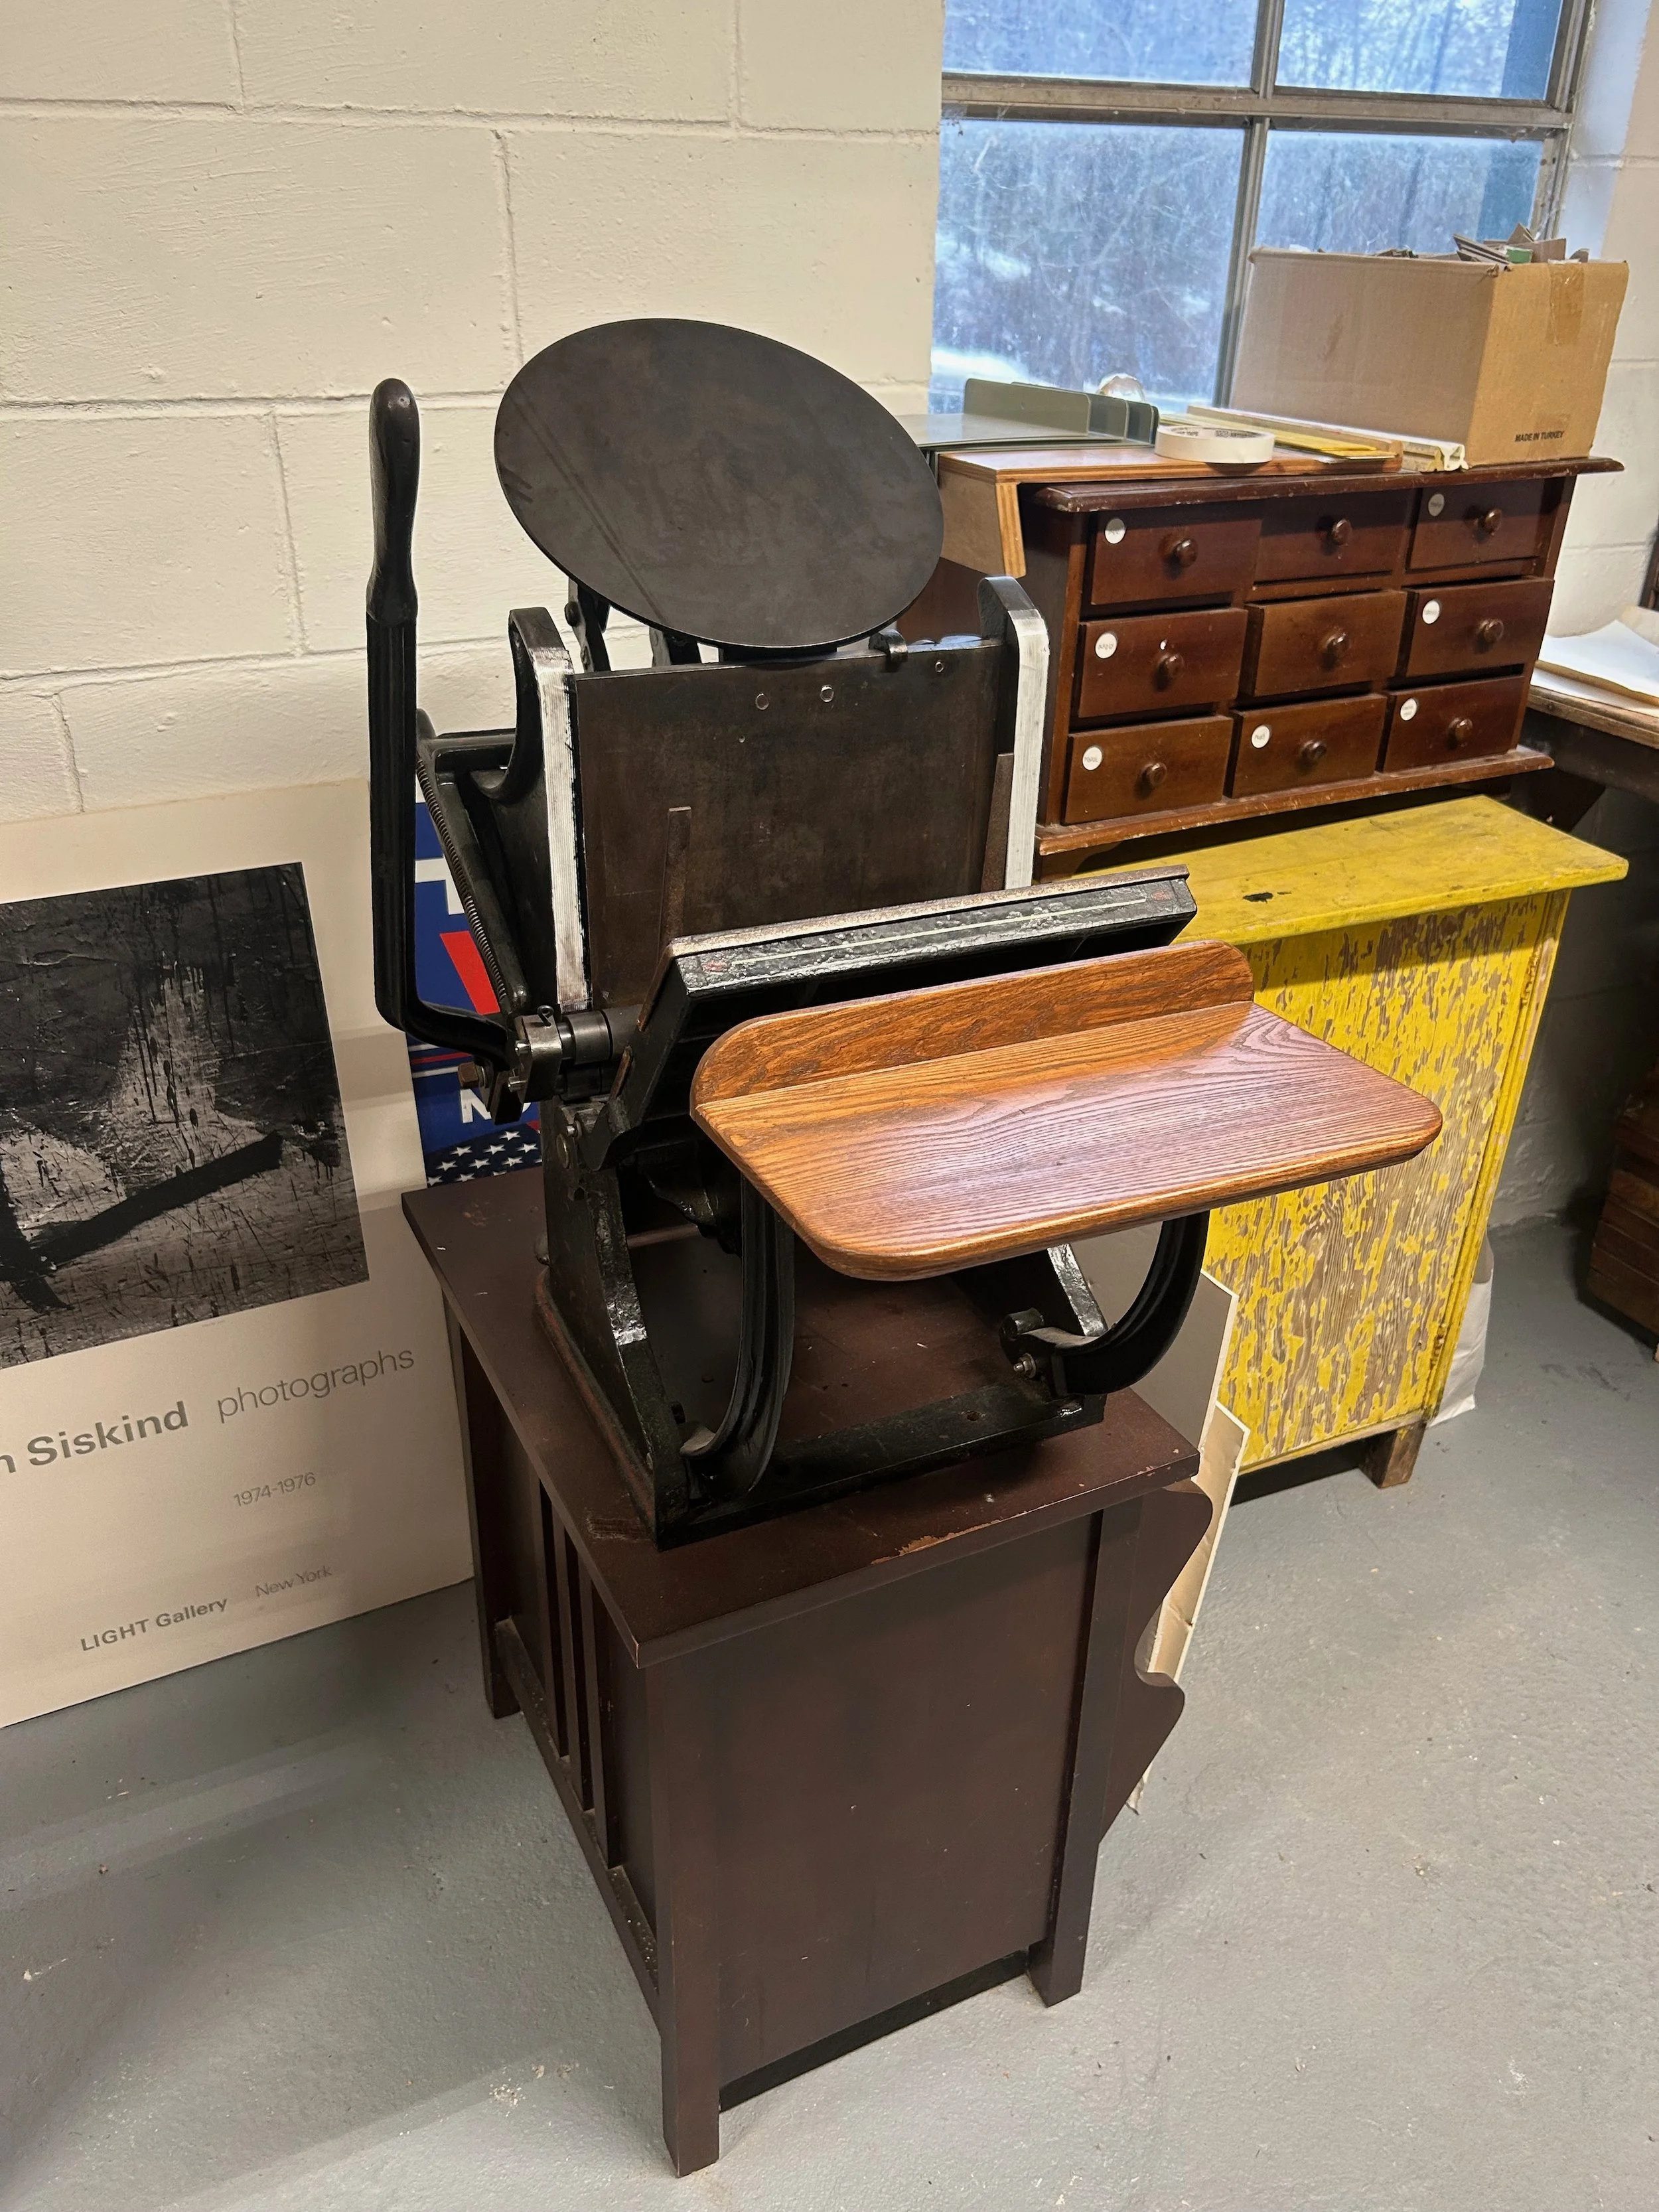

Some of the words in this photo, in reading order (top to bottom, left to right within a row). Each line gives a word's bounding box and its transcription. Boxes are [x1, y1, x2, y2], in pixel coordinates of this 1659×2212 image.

[1515, 433, 1532, 442] MADE
[1541, 430, 1564, 439] TURKEY
[27, 1400, 188, 1465] Siskind
[218, 1350, 414, 1424] photographs
[234, 1472, 316, 1507] 1974-1976
[80, 1619, 150, 1651] LIGHT
[155, 1598, 228, 1628] Gallery
[255, 1578, 294, 1597] New
[296, 1564, 332, 1585] York
